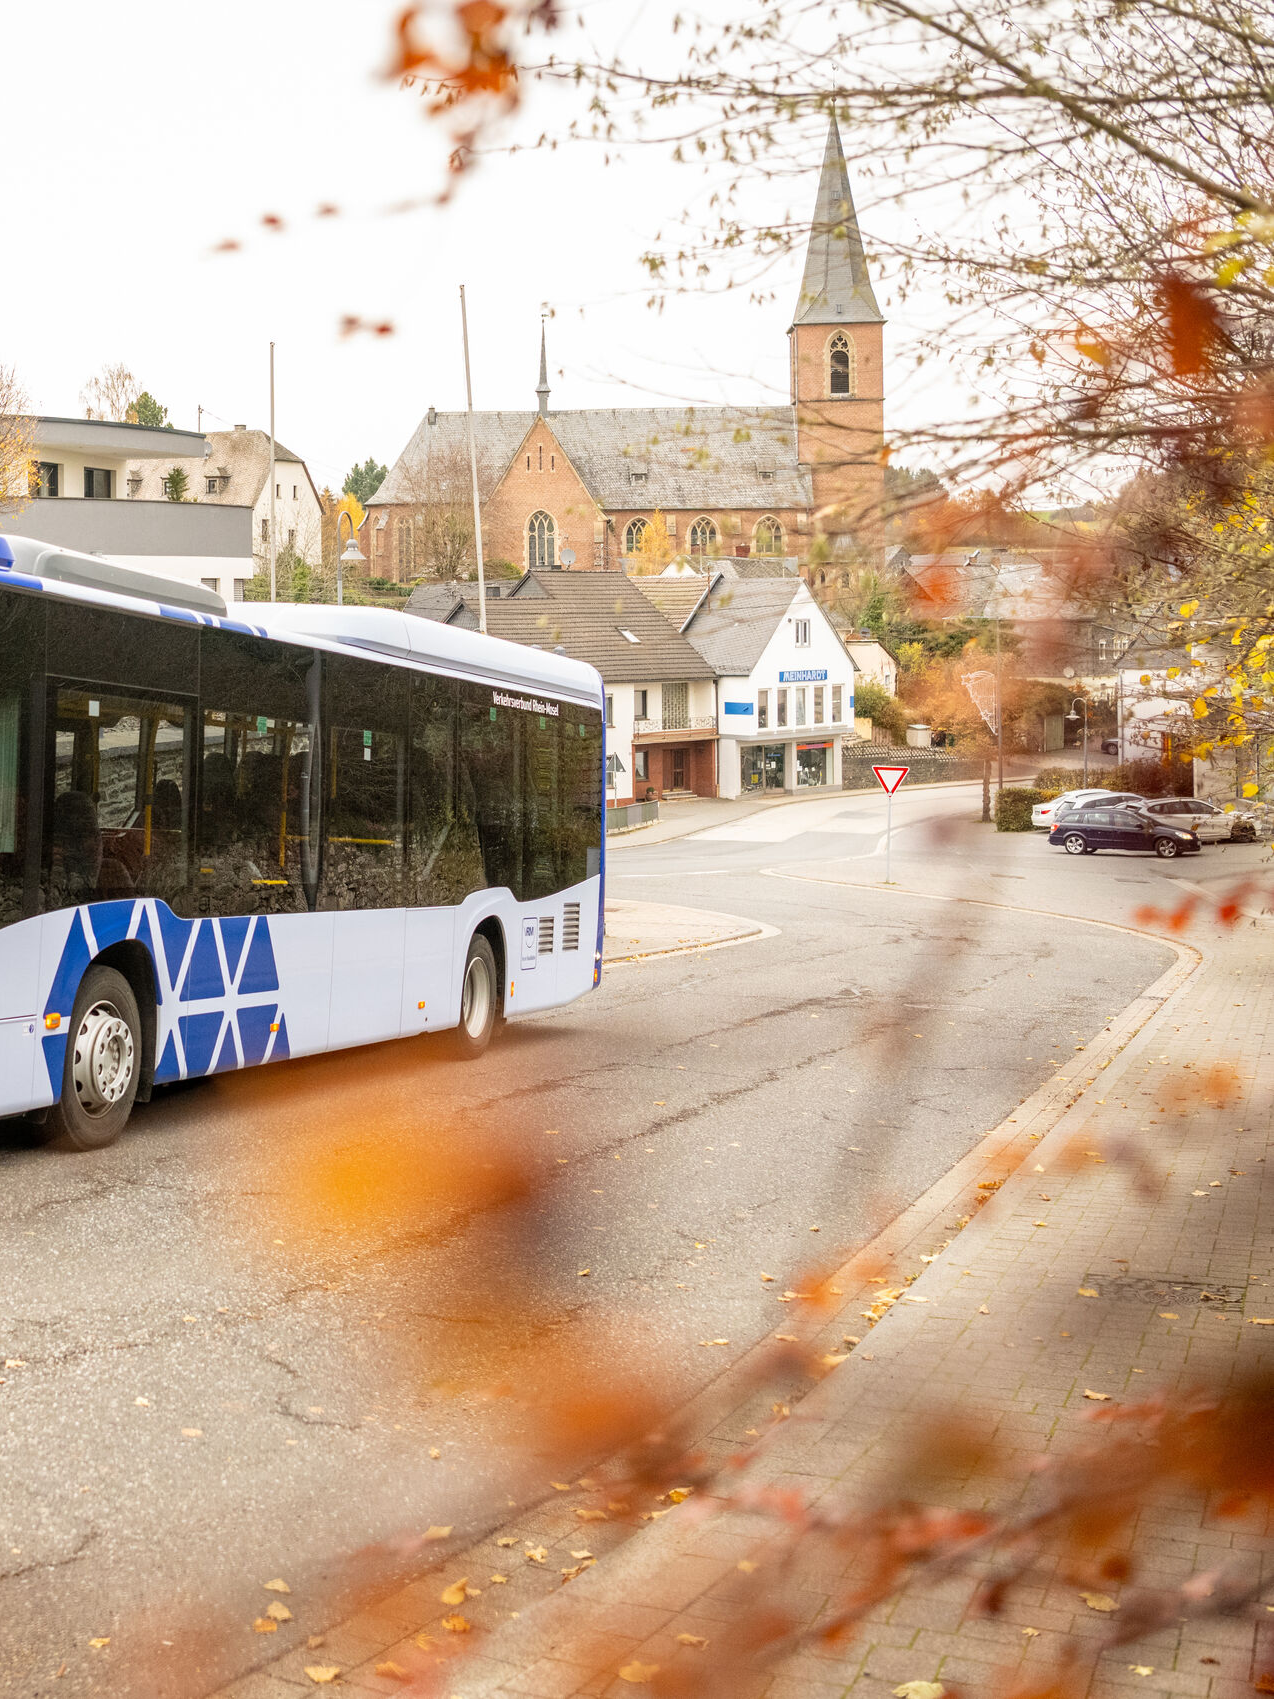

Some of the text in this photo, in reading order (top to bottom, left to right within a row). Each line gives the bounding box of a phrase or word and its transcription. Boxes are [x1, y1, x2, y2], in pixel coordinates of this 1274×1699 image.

[782, 670, 826, 682] MEINHARDT
[492, 691, 559, 716] Verkehrsverbund Rhein-Mosel
